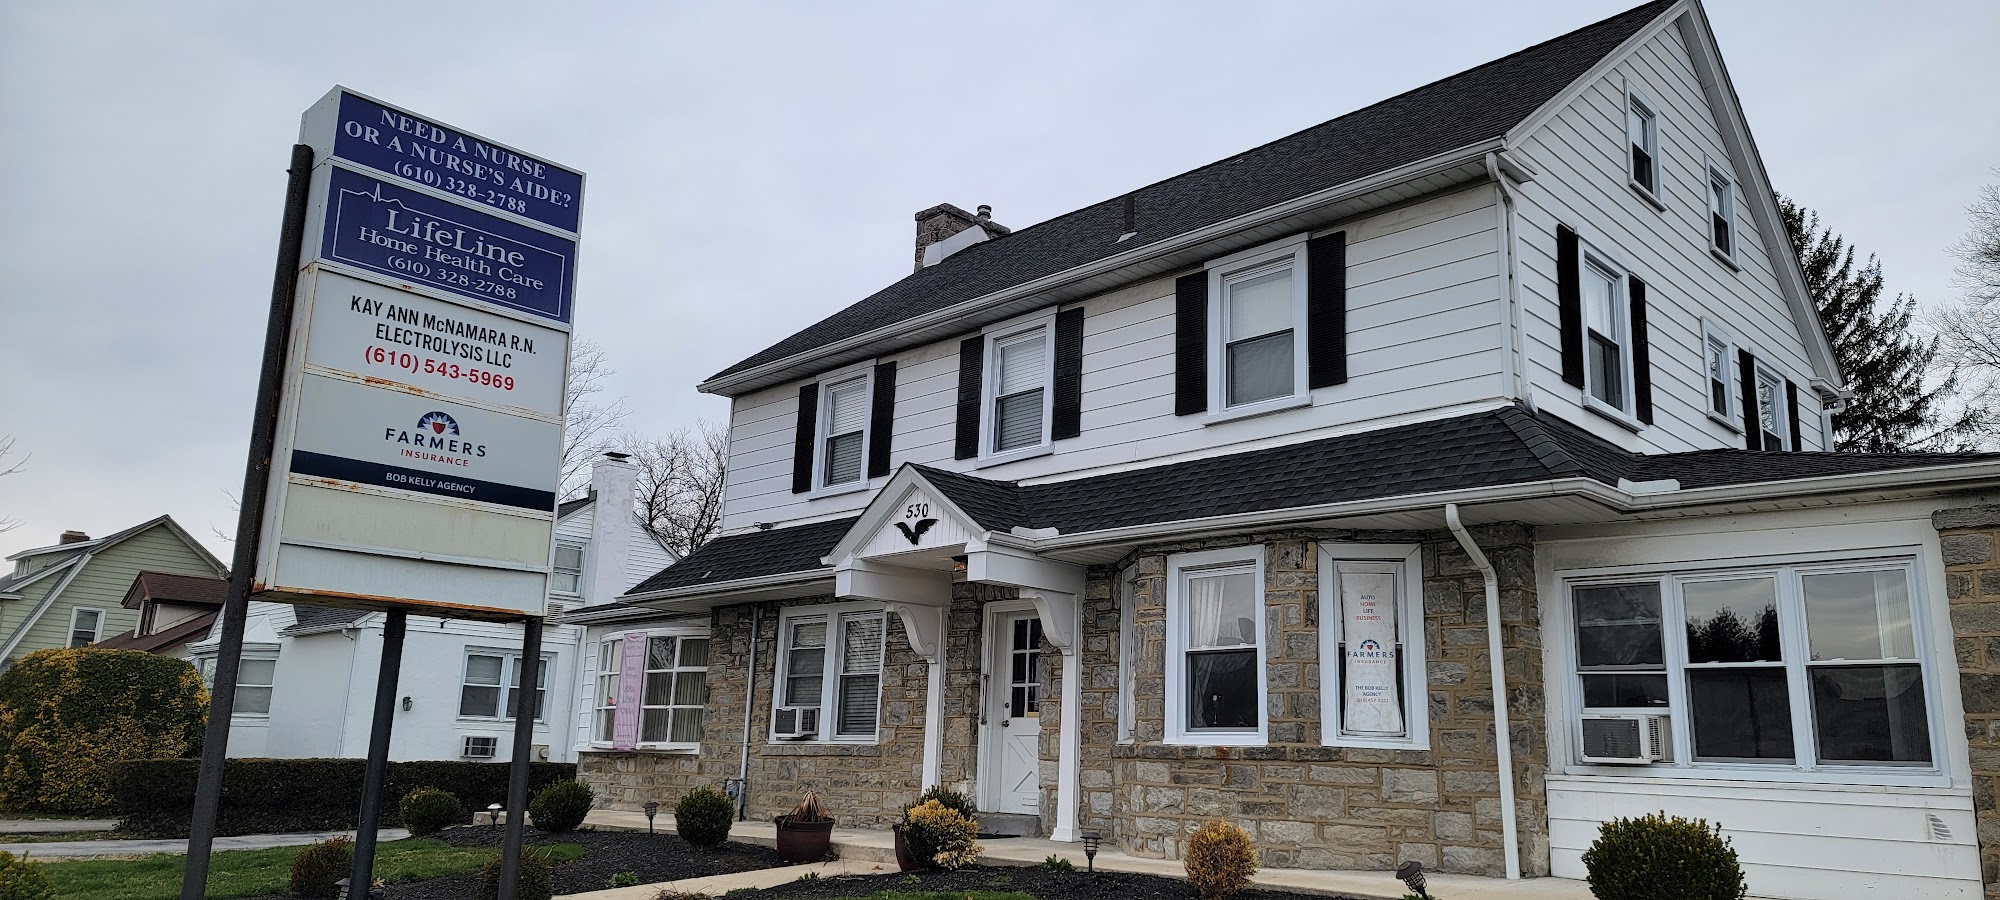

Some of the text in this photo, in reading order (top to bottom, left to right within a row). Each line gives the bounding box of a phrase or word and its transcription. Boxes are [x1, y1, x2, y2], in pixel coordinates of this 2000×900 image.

[345, 120, 572, 208] OR A NURSE'S AIDE?
[380, 109, 546, 180] NEED A NURSE
[394, 160, 526, 214] (610) 328-2788
[358, 225, 544, 290] Home Health Care
[385, 208, 525, 268] LifeLine
[387, 255, 516, 300] (610) 328-2788
[350, 295, 537, 355] KAY ANN McNAMARA R.N.
[375, 322, 512, 369] ELECTROLYSIS LLC
[365, 345, 515, 391] (610) 543-5969
[385, 427, 487, 458] FARMERS
[400, 448, 469, 468] INSURANCE
[385, 472, 476, 494] BOB KELLY AGENCY
[906, 503, 929, 518] 530
[1347, 651, 1394, 659] FARMERS
